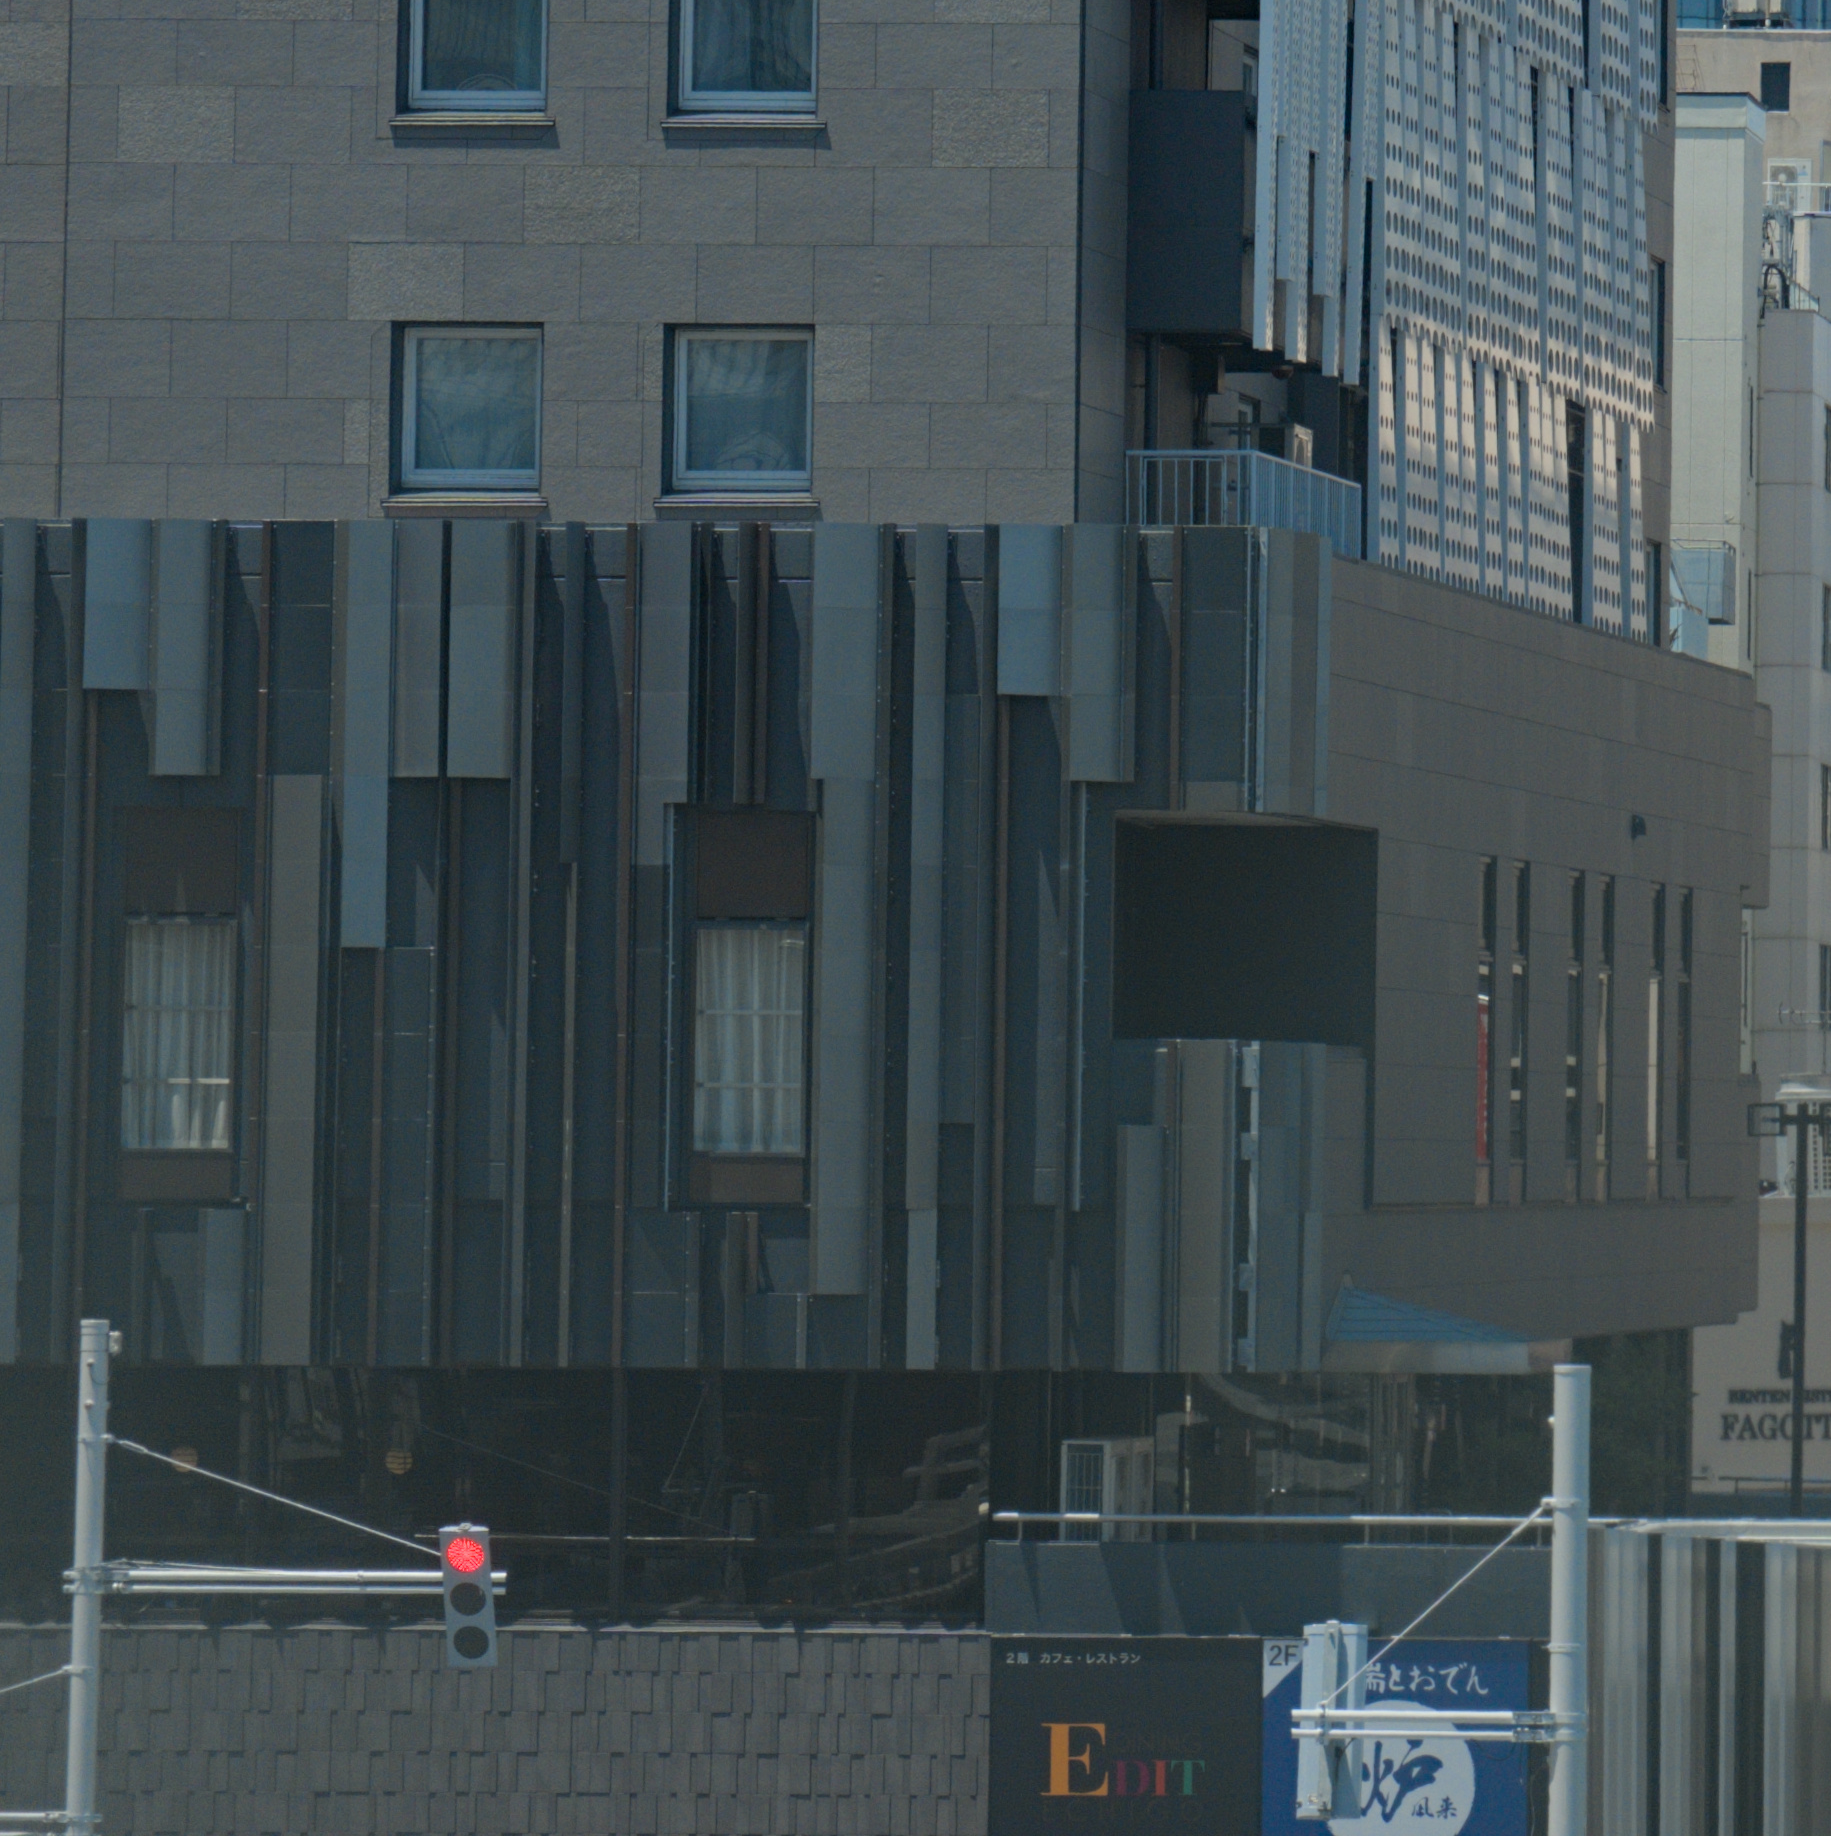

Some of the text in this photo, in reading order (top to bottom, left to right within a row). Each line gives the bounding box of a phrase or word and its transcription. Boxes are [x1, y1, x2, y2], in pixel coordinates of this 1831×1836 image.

[1728, 1388, 1791, 1404] BENTEN
[1039, 1652, 1142, 1665] カフェ・レストラン
[1268, 1644, 1299, 1667] 2F
[1040, 1722, 1206, 1797] EDIT
